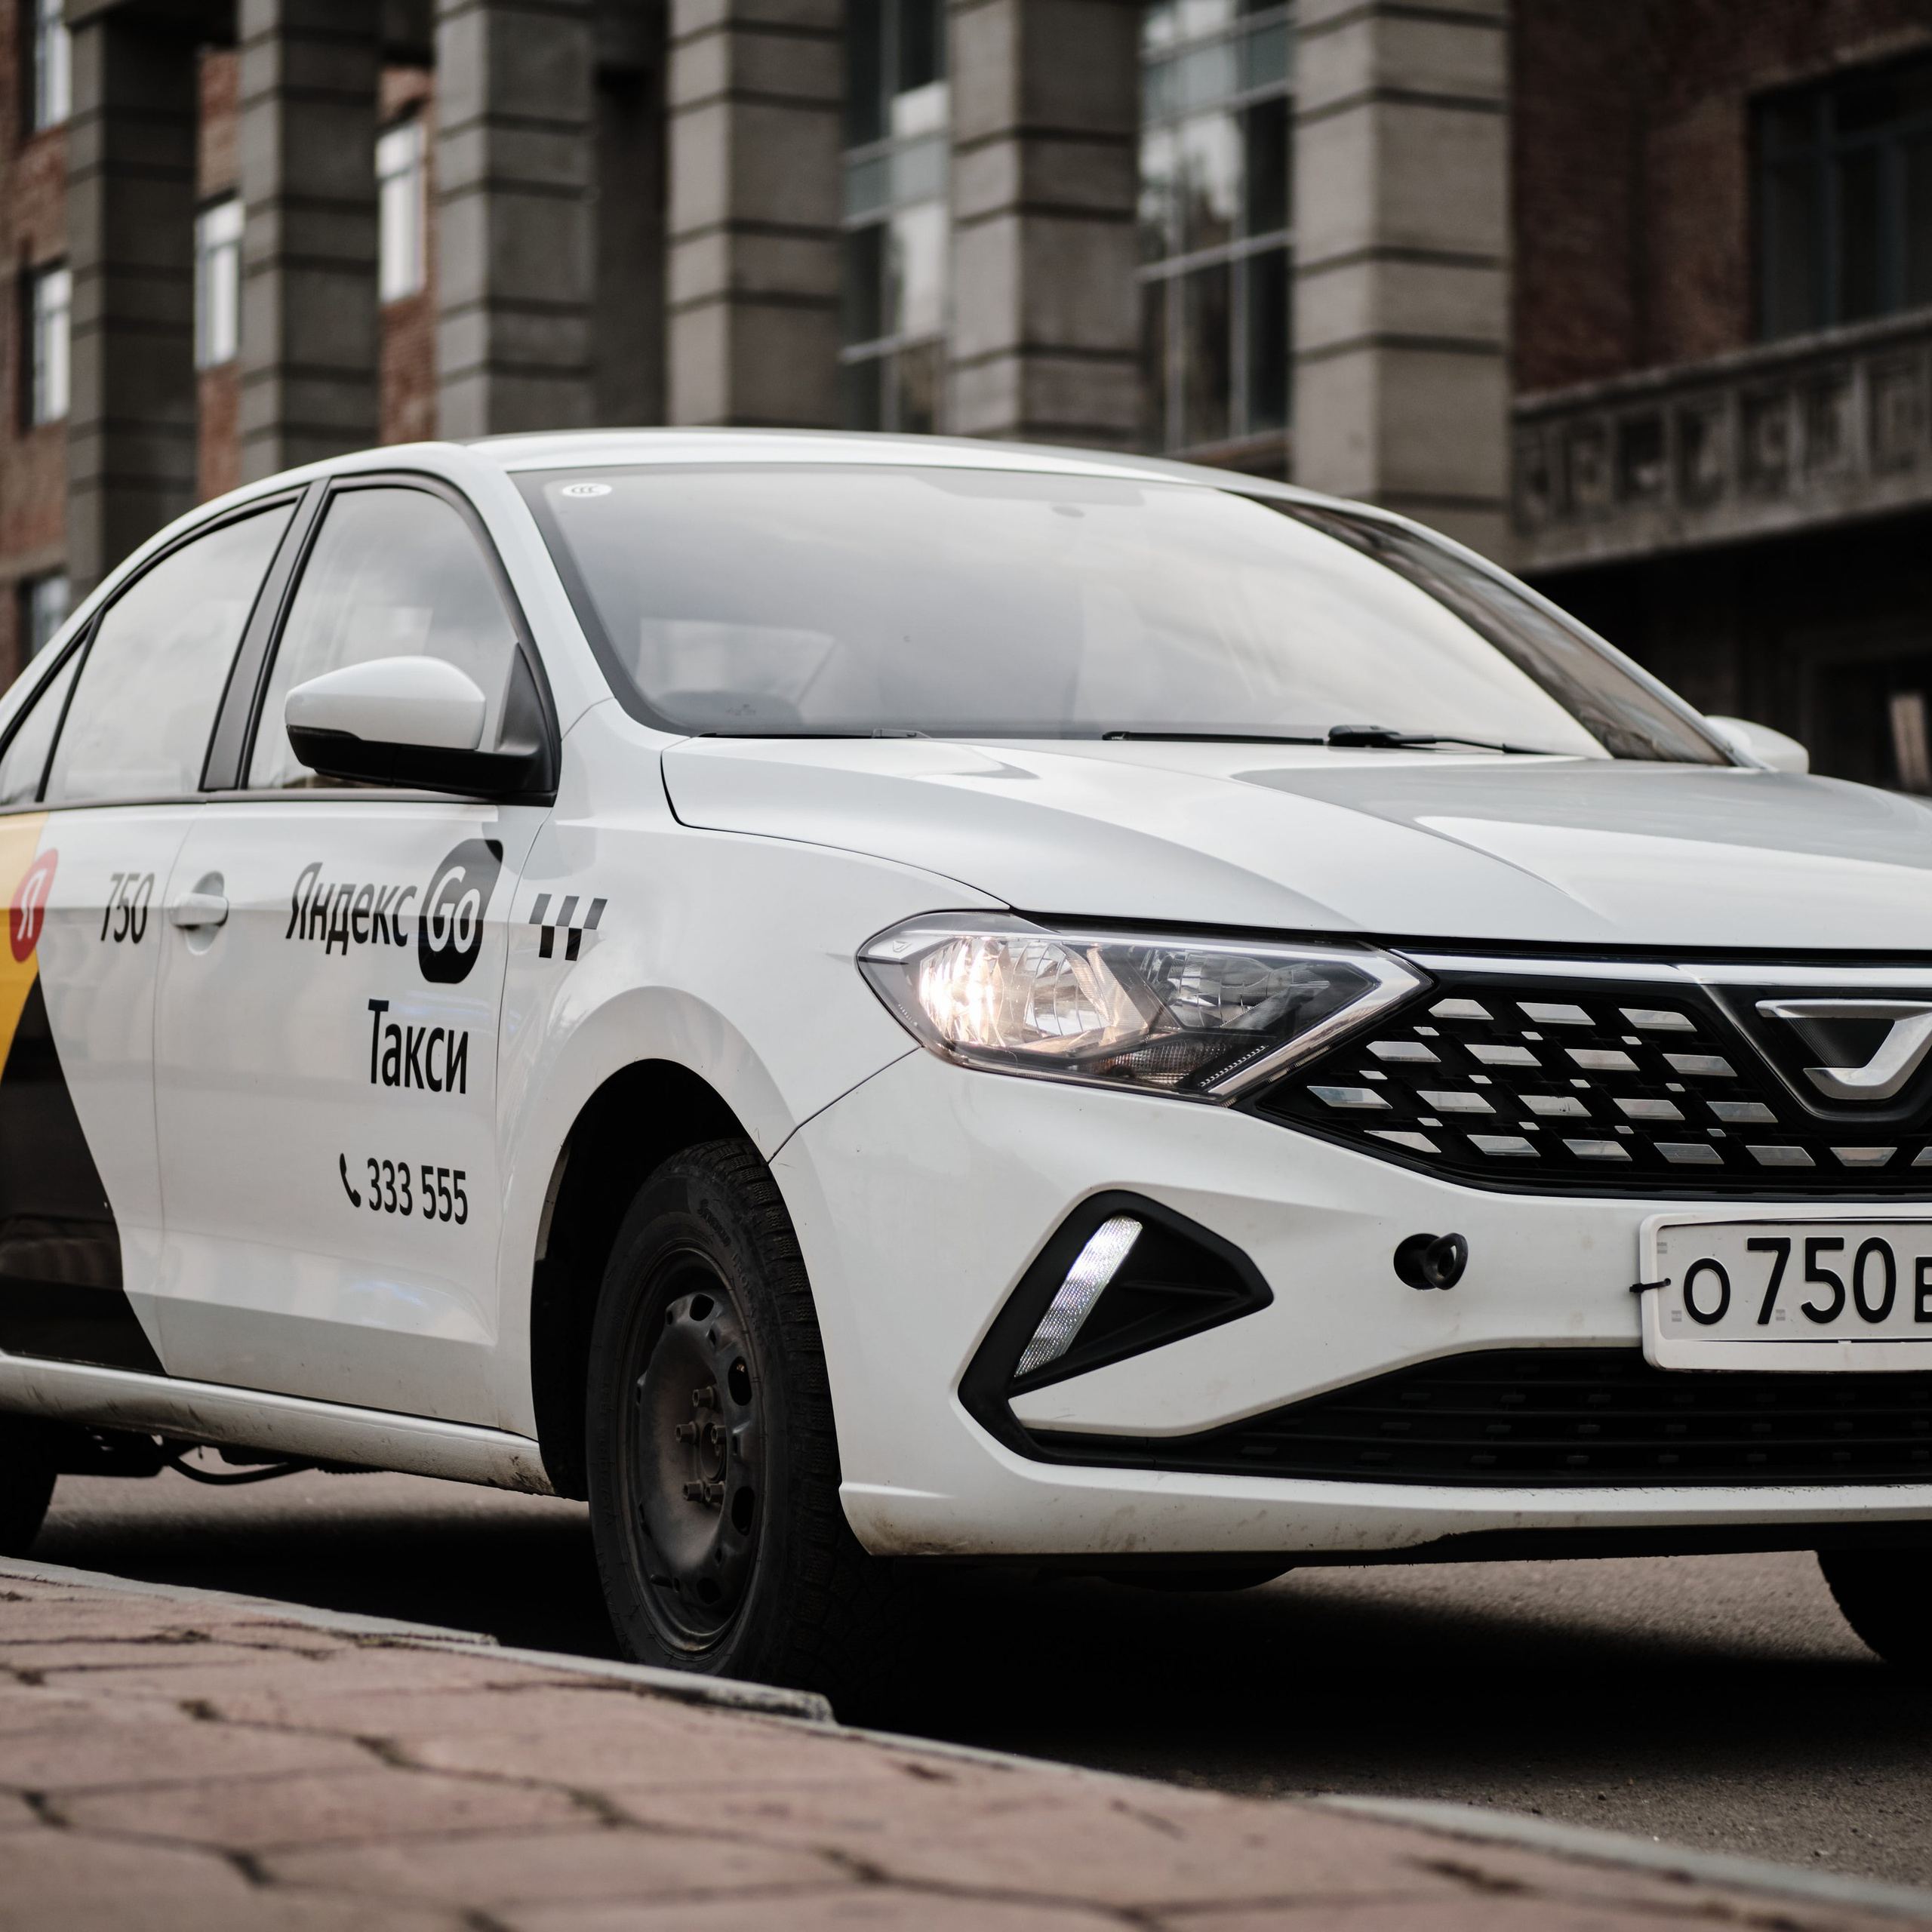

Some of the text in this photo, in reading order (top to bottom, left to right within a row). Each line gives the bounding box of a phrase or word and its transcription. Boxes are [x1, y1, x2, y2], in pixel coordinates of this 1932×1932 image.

[17, 869, 48, 940] Я
[100, 872, 155, 944] 750
[285, 862, 481, 955] Яндекс Go
[368, 998, 469, 1094] Такси
[367, 1158, 468, 1226] 333 555
